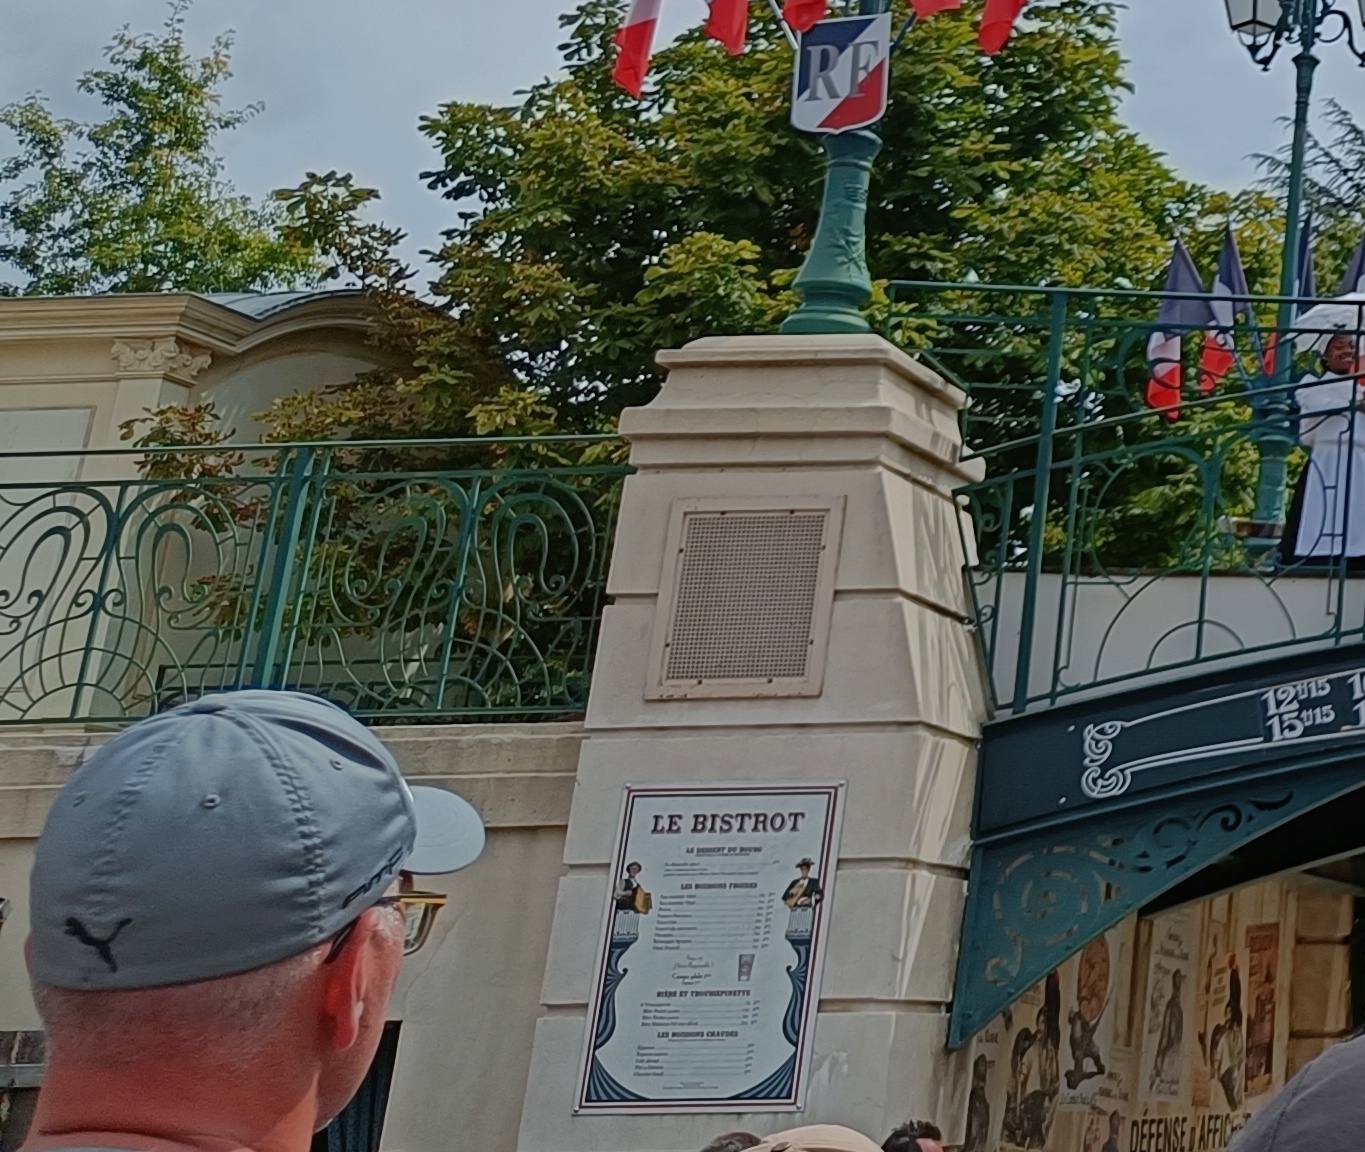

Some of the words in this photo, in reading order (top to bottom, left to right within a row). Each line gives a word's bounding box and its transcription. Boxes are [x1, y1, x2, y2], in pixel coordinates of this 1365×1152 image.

[804, 40, 879, 102] RF
[650, 814, 683, 835] LE
[691, 811, 807, 834] BISTROT
